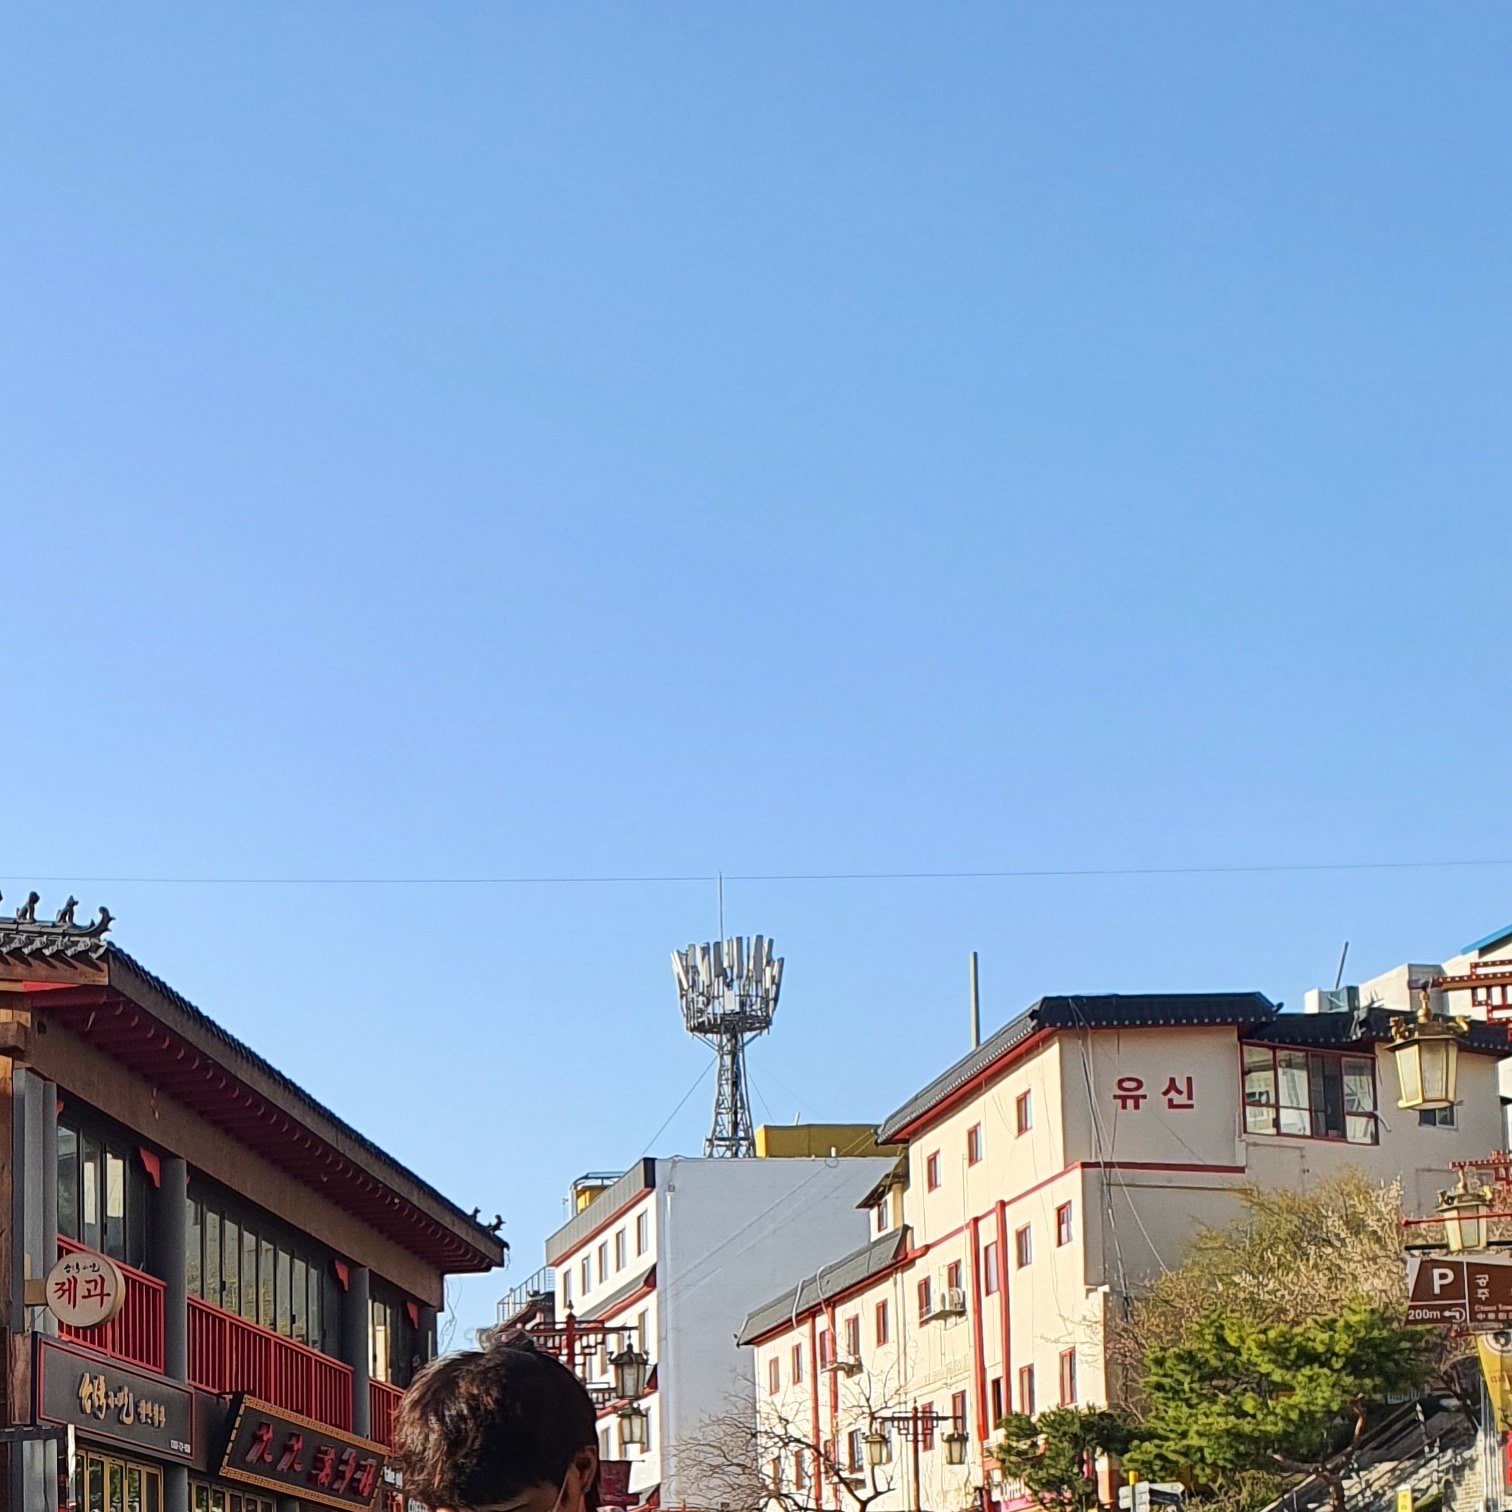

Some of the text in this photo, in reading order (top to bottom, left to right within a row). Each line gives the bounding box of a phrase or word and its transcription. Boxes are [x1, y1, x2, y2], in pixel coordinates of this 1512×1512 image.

[53, 1274, 112, 1310] 제과
[1432, 1268, 1455, 1295] P
[1408, 1309, 1440, 1320] 200m
